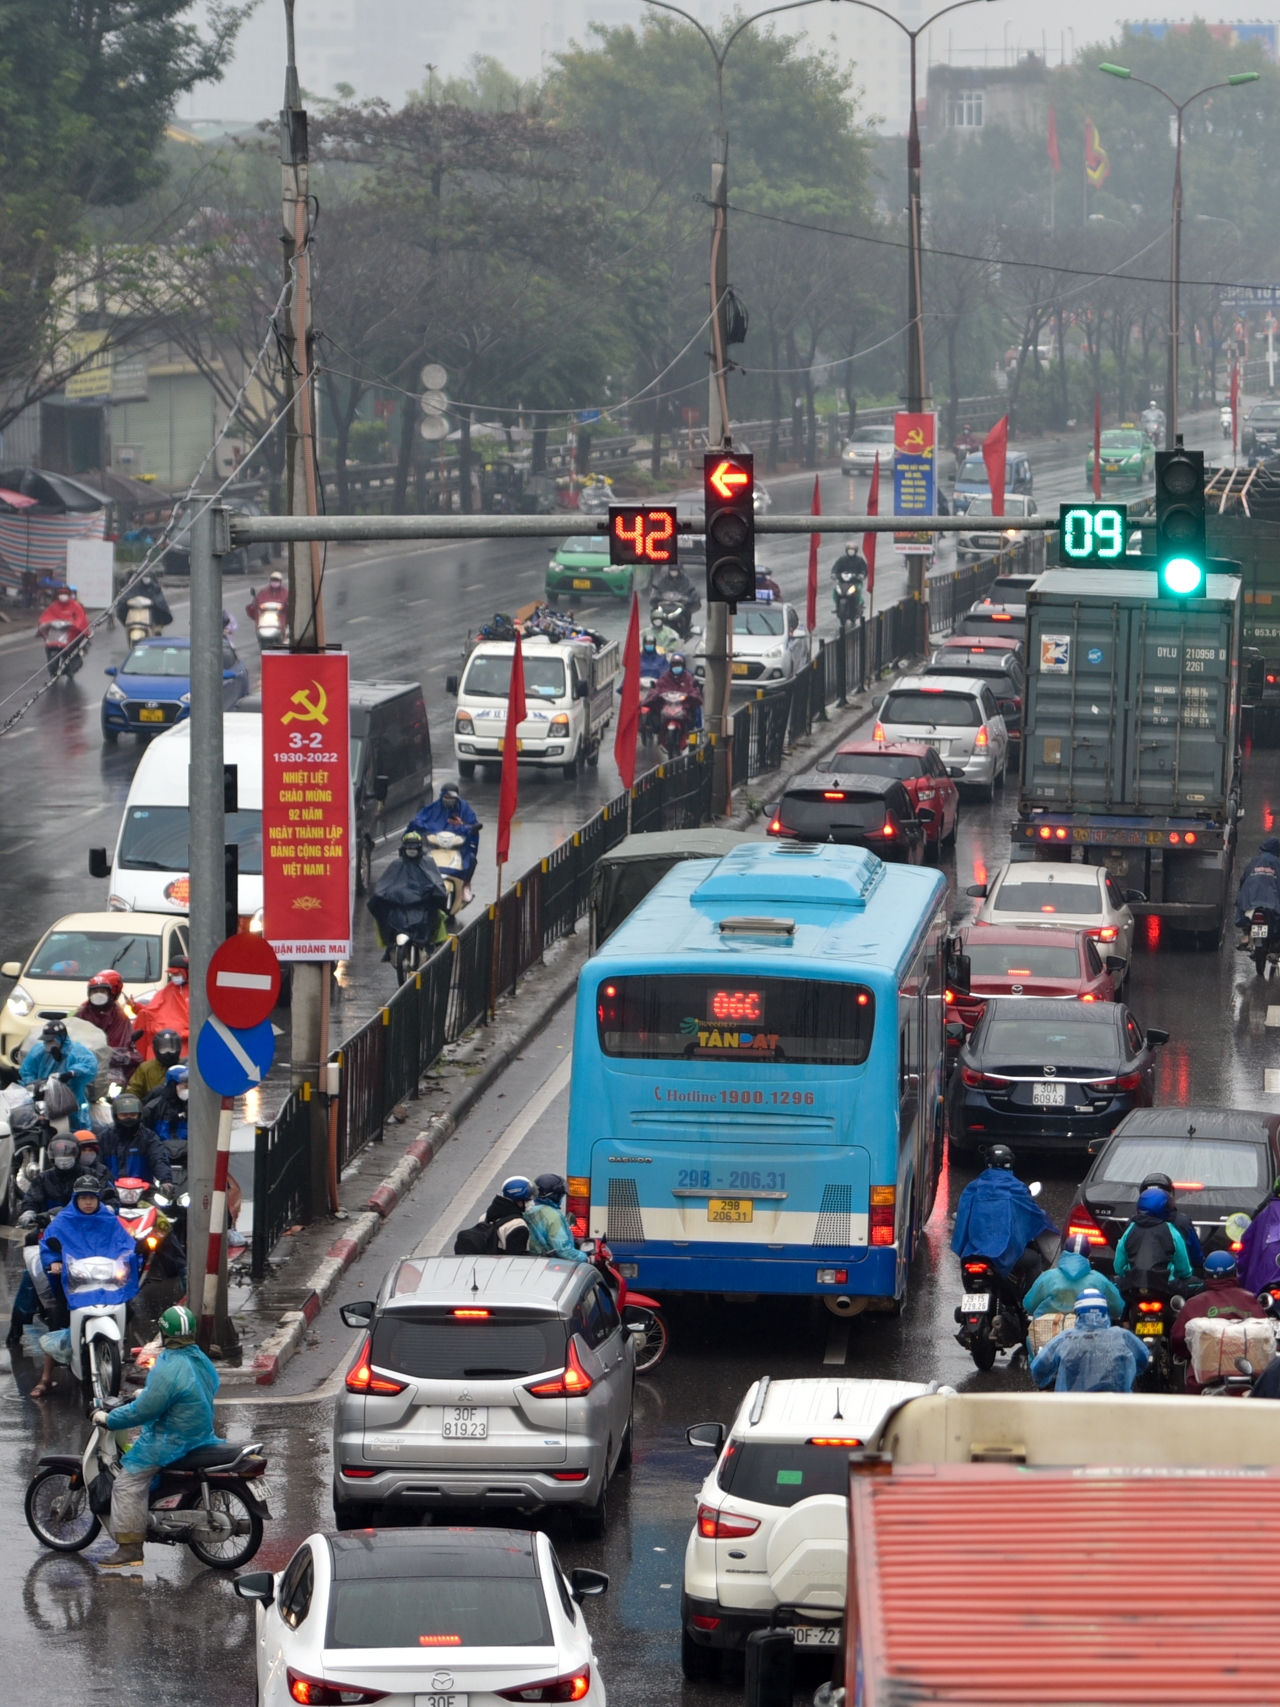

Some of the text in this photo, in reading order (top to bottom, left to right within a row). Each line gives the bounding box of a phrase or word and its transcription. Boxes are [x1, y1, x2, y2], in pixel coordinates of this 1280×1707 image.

[615, 512, 673, 559] 42
[1064, 510, 1121, 557] 09
[1157, 646, 1177, 658] DYLU
[1186, 648, 1215, 660] 210958
[289, 733, 323, 749] 3-2
[273, 753, 338, 764] 1930-2022
[283, 772, 329, 788] NHIỆT LIỆT
[279, 789, 303, 803] CHÀO
[289, 808, 323, 822] 92 NĂM
[269, 826, 343, 842] NGÀY THÀNH LẬP
[270, 842, 295, 859] ĐẢNG
[297, 844, 322, 861] CỘNG
[282, 864, 301, 880] VIỆT
[303, 864, 324, 876] NAM
[272, 944, 346, 957] UẬN HOÀNG MAI
[1041, 1083, 1057, 1093] 30A
[667, 1090, 815, 1106] Hotline 1900.1296
[1034, 1095, 1064, 1105] 609.43
[608, 1156, 653, 1164] DAEWOO
[678, 1169, 711, 1189] 29B
[729, 1171, 787, 1192] 206.31
[721, 1201, 741, 1211] 29B
[712, 1211, 748, 1222] 206.31
[454, 1407, 476, 1420] 30F
[444, 1422, 486, 1437] 819.23
